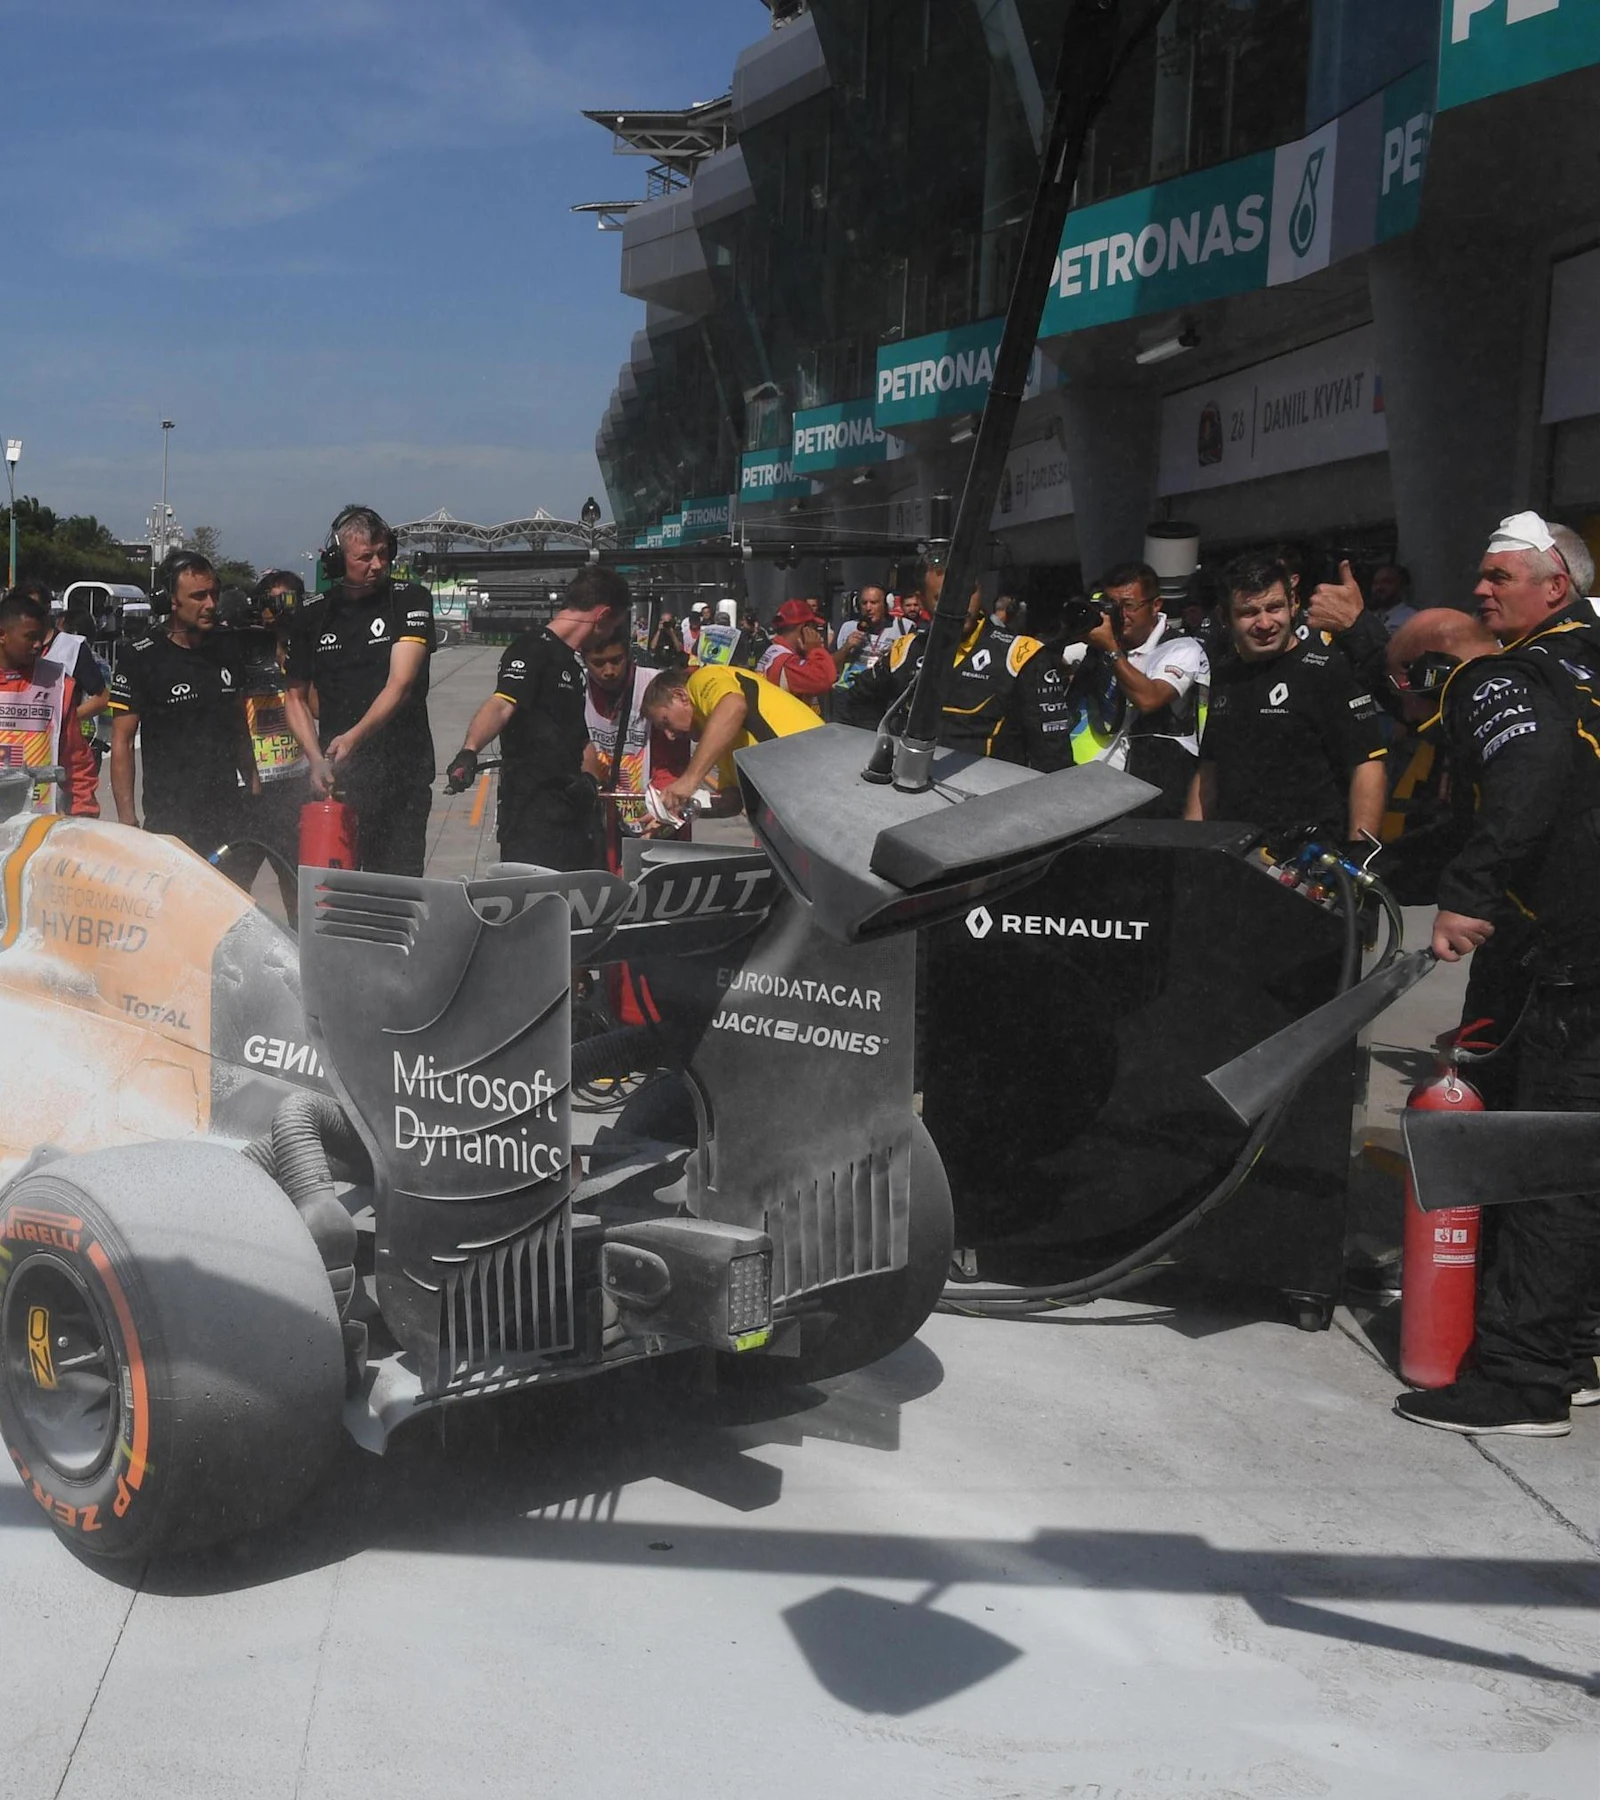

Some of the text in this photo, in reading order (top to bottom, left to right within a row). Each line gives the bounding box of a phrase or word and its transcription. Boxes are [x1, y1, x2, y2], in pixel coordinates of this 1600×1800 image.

[878, 345, 1001, 404] PETRONA
[1230, 372, 1364, 442] 26 DANIIL KVYAT
[742, 461, 800, 489] PETRON
[681, 506, 729, 527] PETRONAS
[368, 636, 391, 645] RENAULT
[962, 671, 990, 680] RENAULT
[167, 693, 198, 704] INFINITI
[1468, 687, 1528, 722] INFINITI
[1473, 704, 1533, 738] TOTAL
[1483, 721, 1537, 763] PIRELLI
[42, 856, 175, 893] INFINITI
[472, 868, 772, 928] RNAULT
[42, 908, 149, 953] HYBRID
[1002, 914, 1150, 941] RENAULT
[716, 967, 883, 1012] EURODATACAR
[122, 994, 191, 1030] TOTAL
[712, 1010, 774, 1037] JACK
[393, 1050, 559, 1123] Microsoft
[395, 1105, 563, 1182] Dynamics
[6, 1206, 84, 1253] PIRELLI
